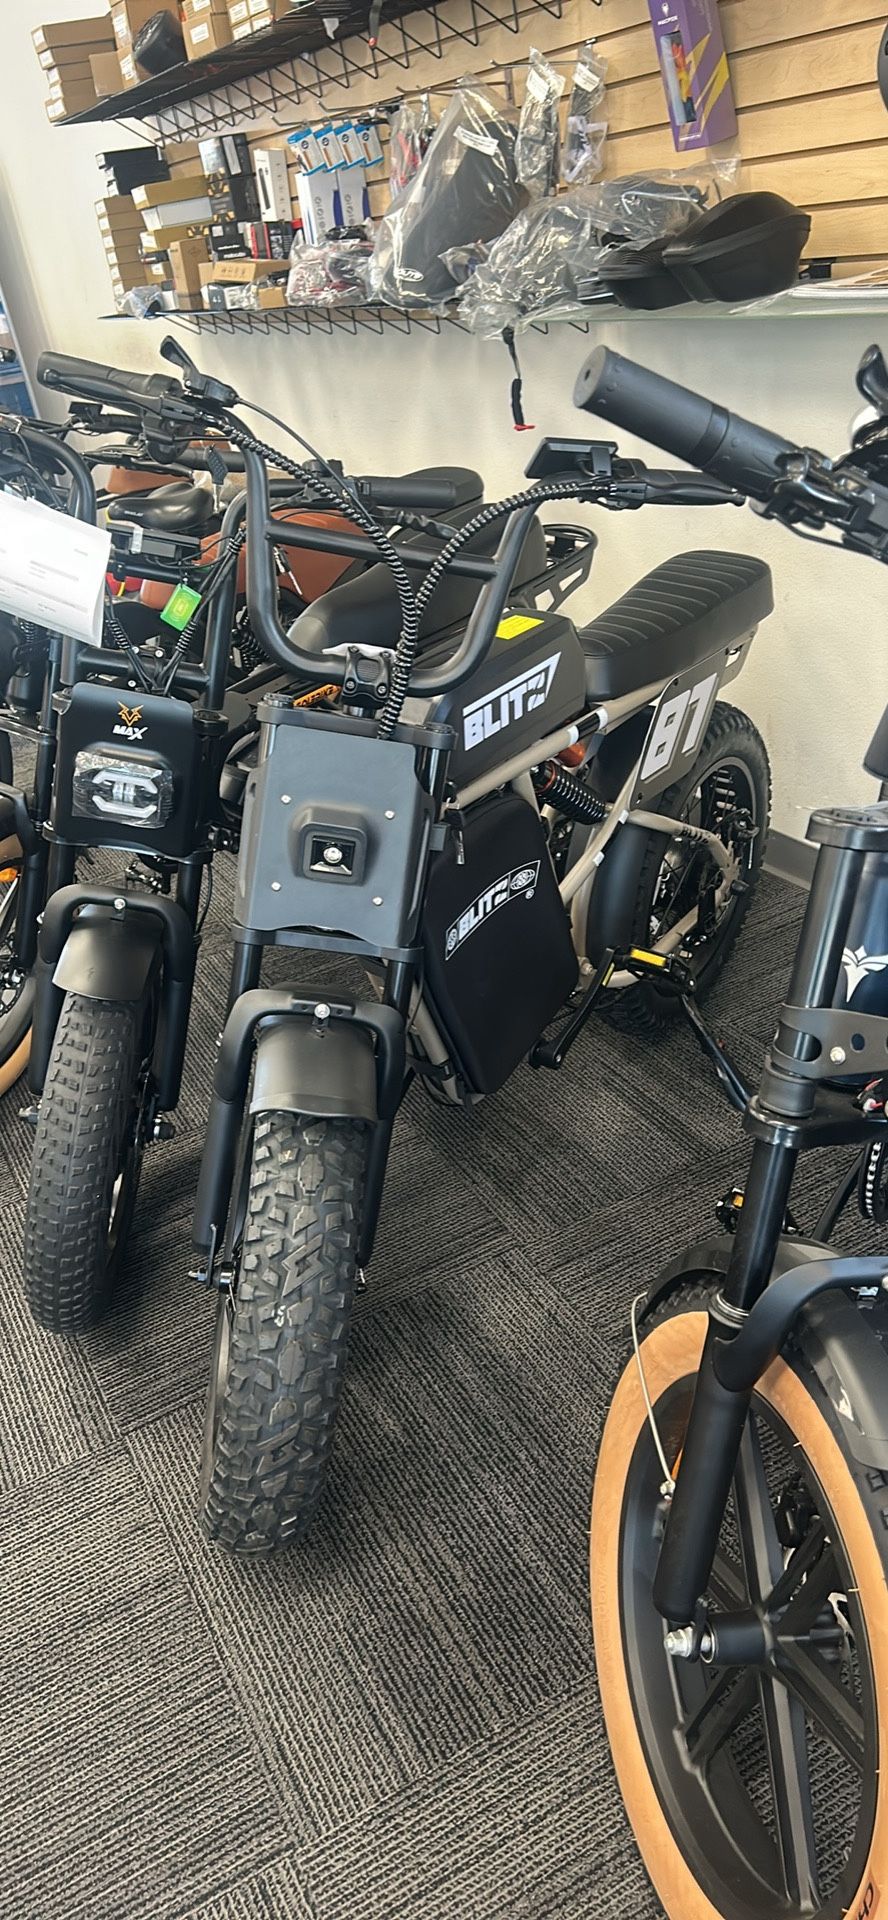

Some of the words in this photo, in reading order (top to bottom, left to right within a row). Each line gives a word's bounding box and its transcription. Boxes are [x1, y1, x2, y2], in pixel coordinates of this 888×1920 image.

[112, 724, 149, 740] MAX
[463, 670, 546, 751] BLITZ
[458, 878, 509, 941] BLITZ
